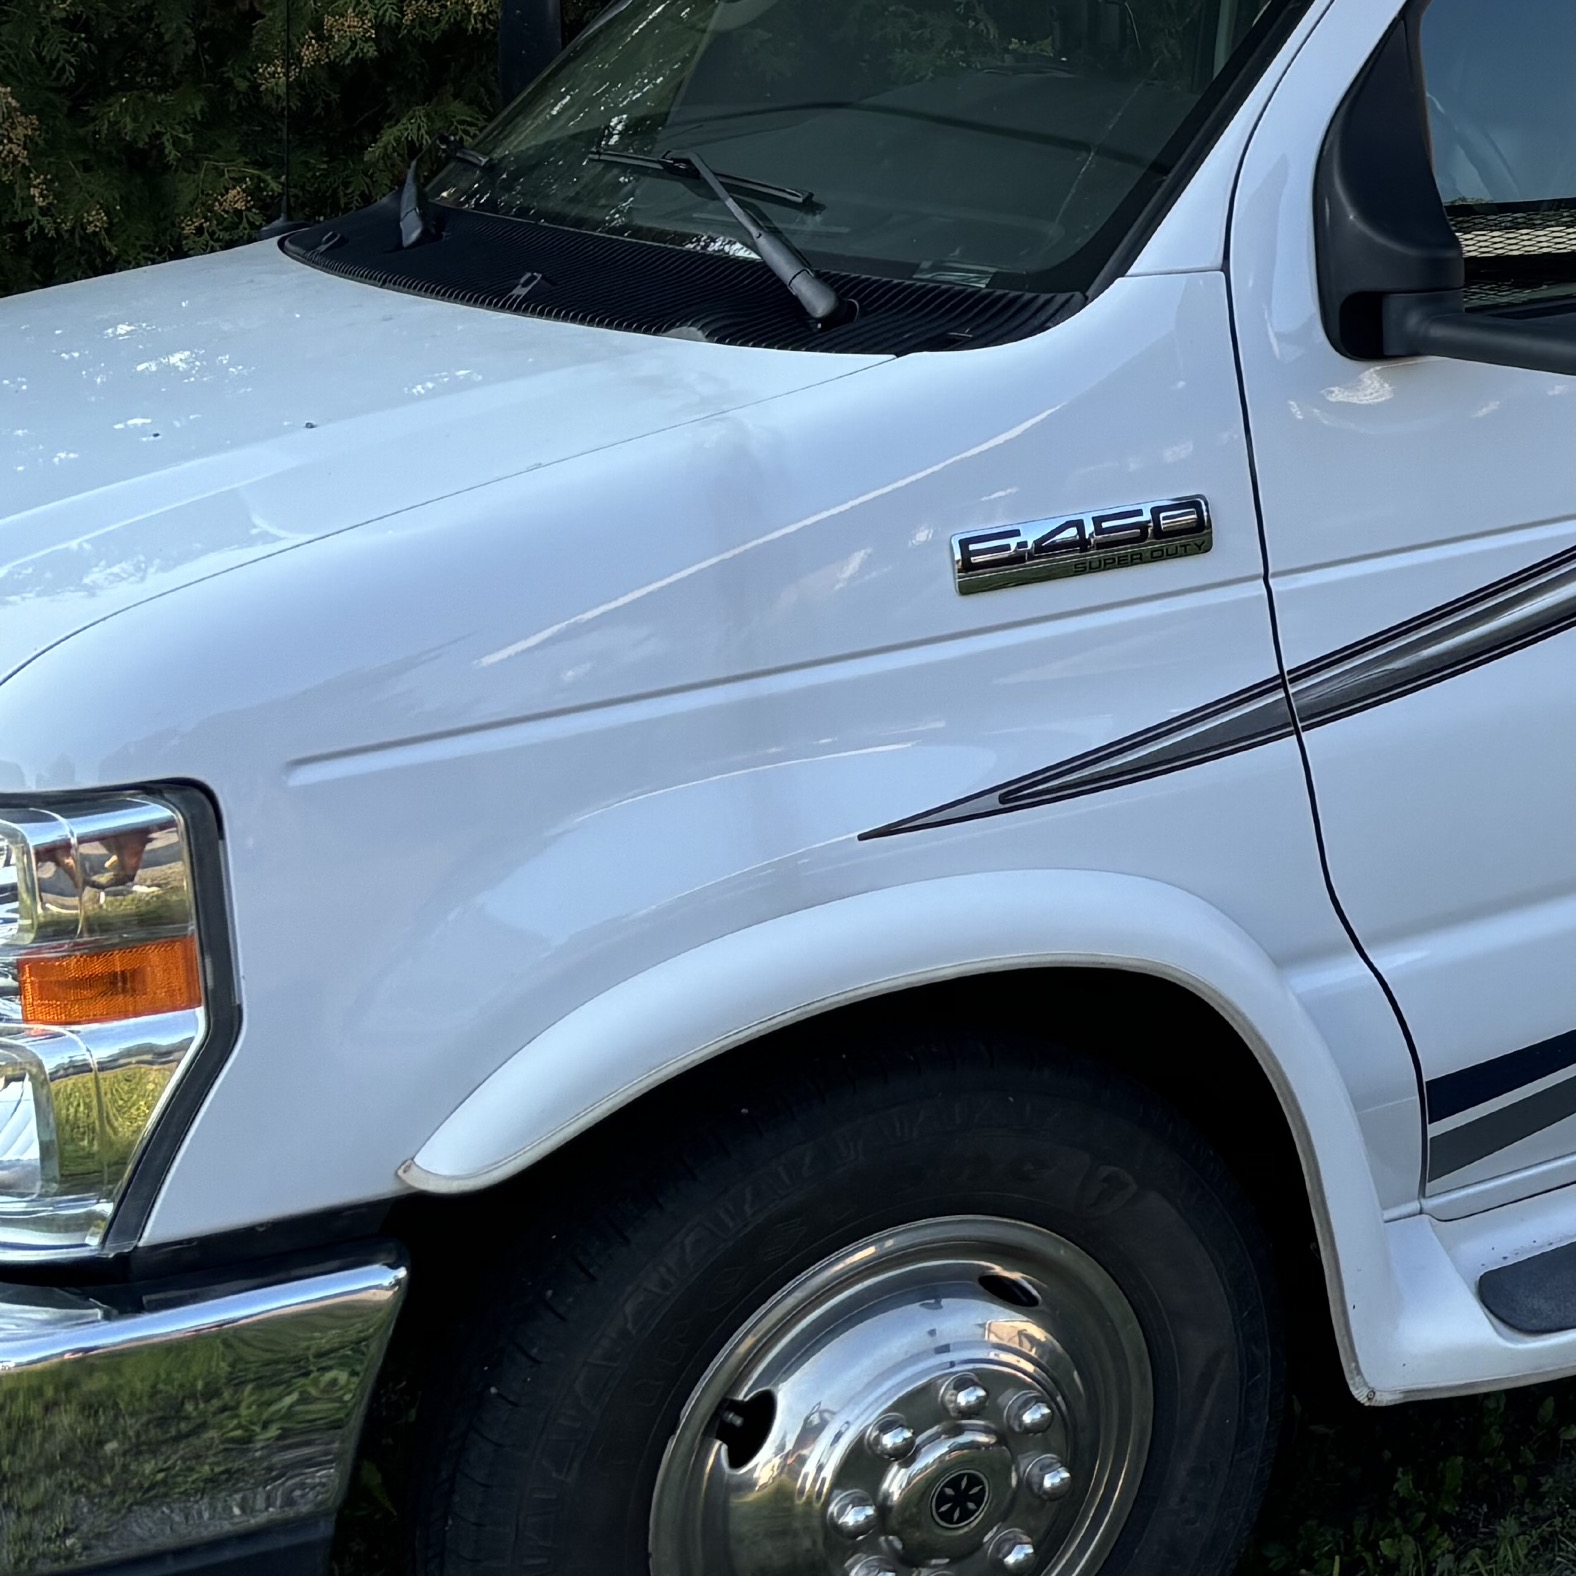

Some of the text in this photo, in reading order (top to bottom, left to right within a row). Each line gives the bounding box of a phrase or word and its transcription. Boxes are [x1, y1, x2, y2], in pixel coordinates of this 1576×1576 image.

[958, 499, 1206, 573] E-450
[1073, 540, 1206, 574] SUPER DUTY
